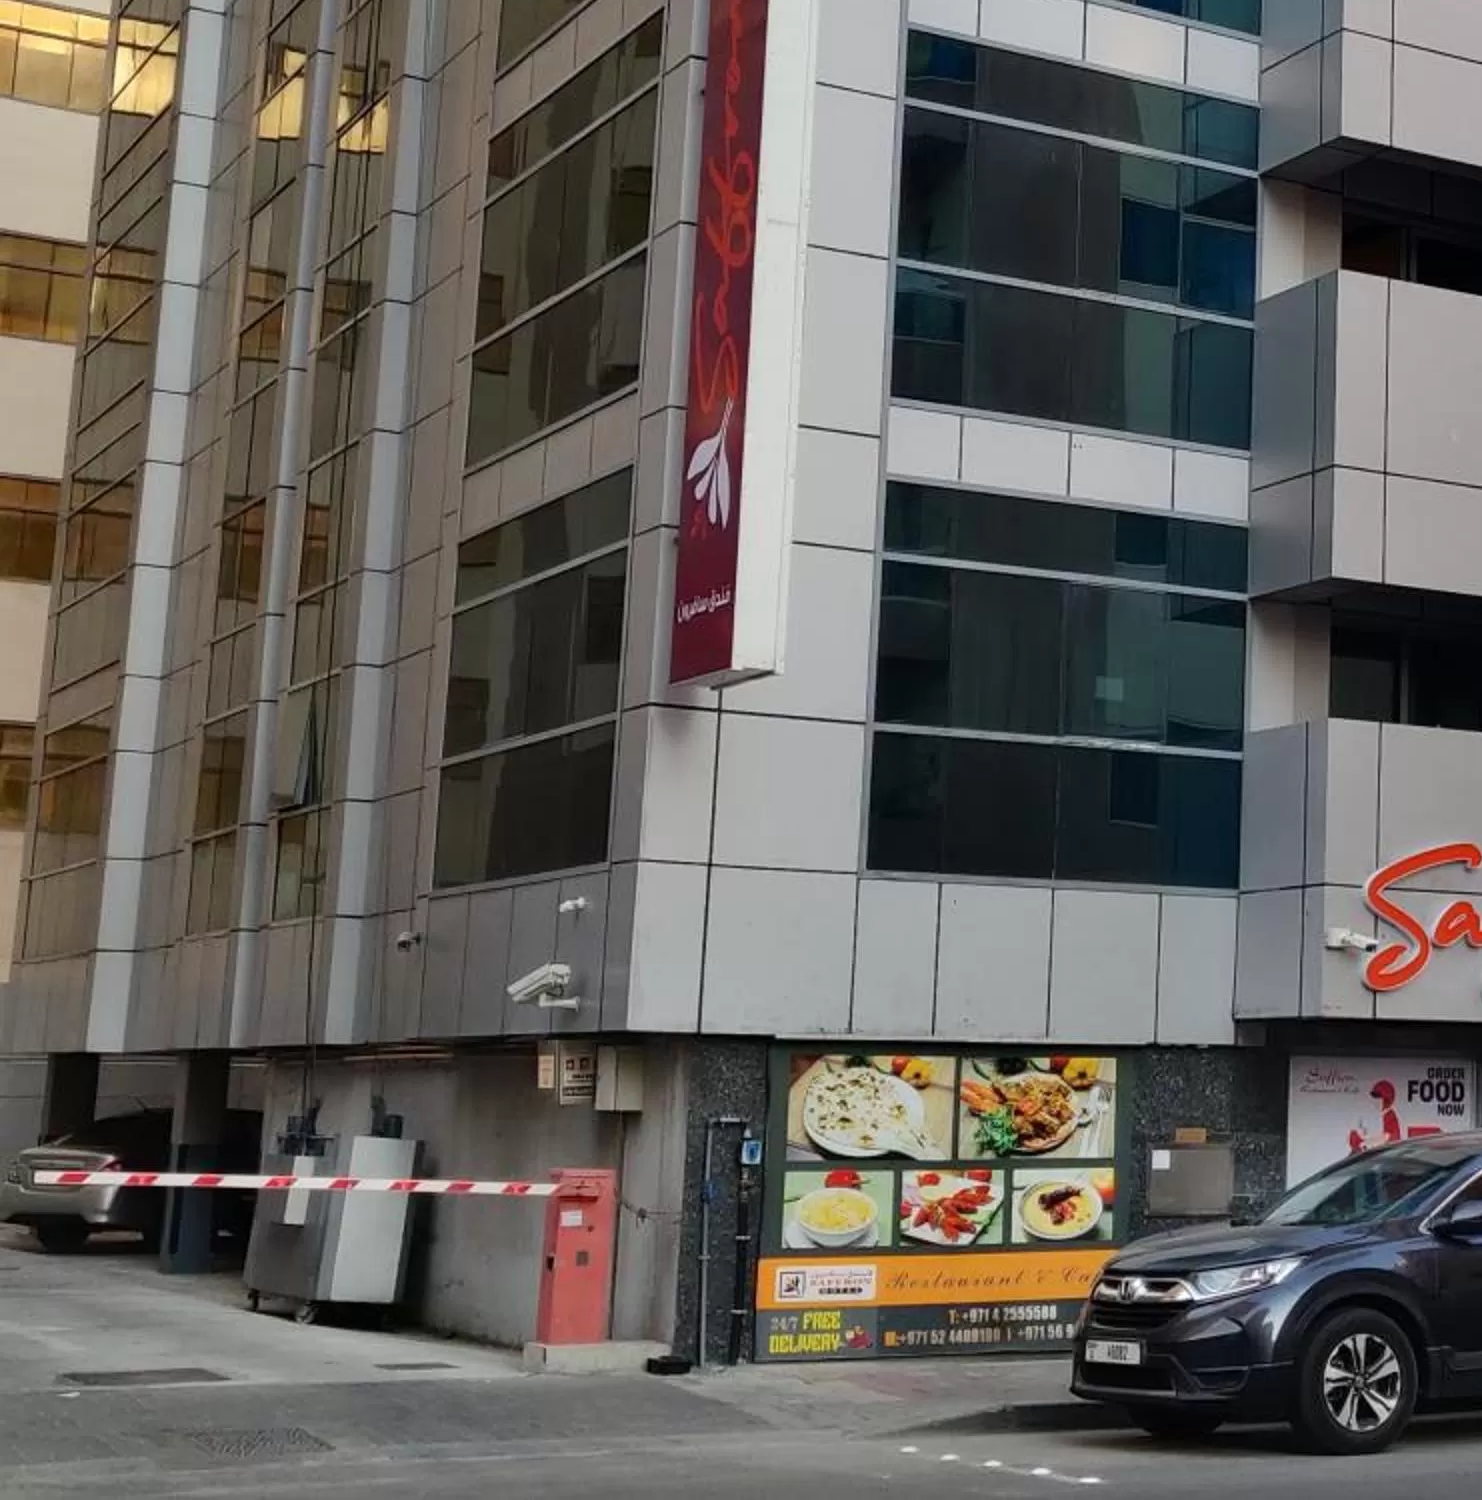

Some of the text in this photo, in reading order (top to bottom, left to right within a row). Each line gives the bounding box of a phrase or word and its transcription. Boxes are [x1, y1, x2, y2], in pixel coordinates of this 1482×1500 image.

[1427, 1067, 1465, 1079] ORDER
[1407, 1080, 1465, 1103] FOOD
[1437, 1104, 1465, 1116] NOW
[803, 1310, 841, 1330] FREE
[768, 1333, 840, 1354] DELIVERY
